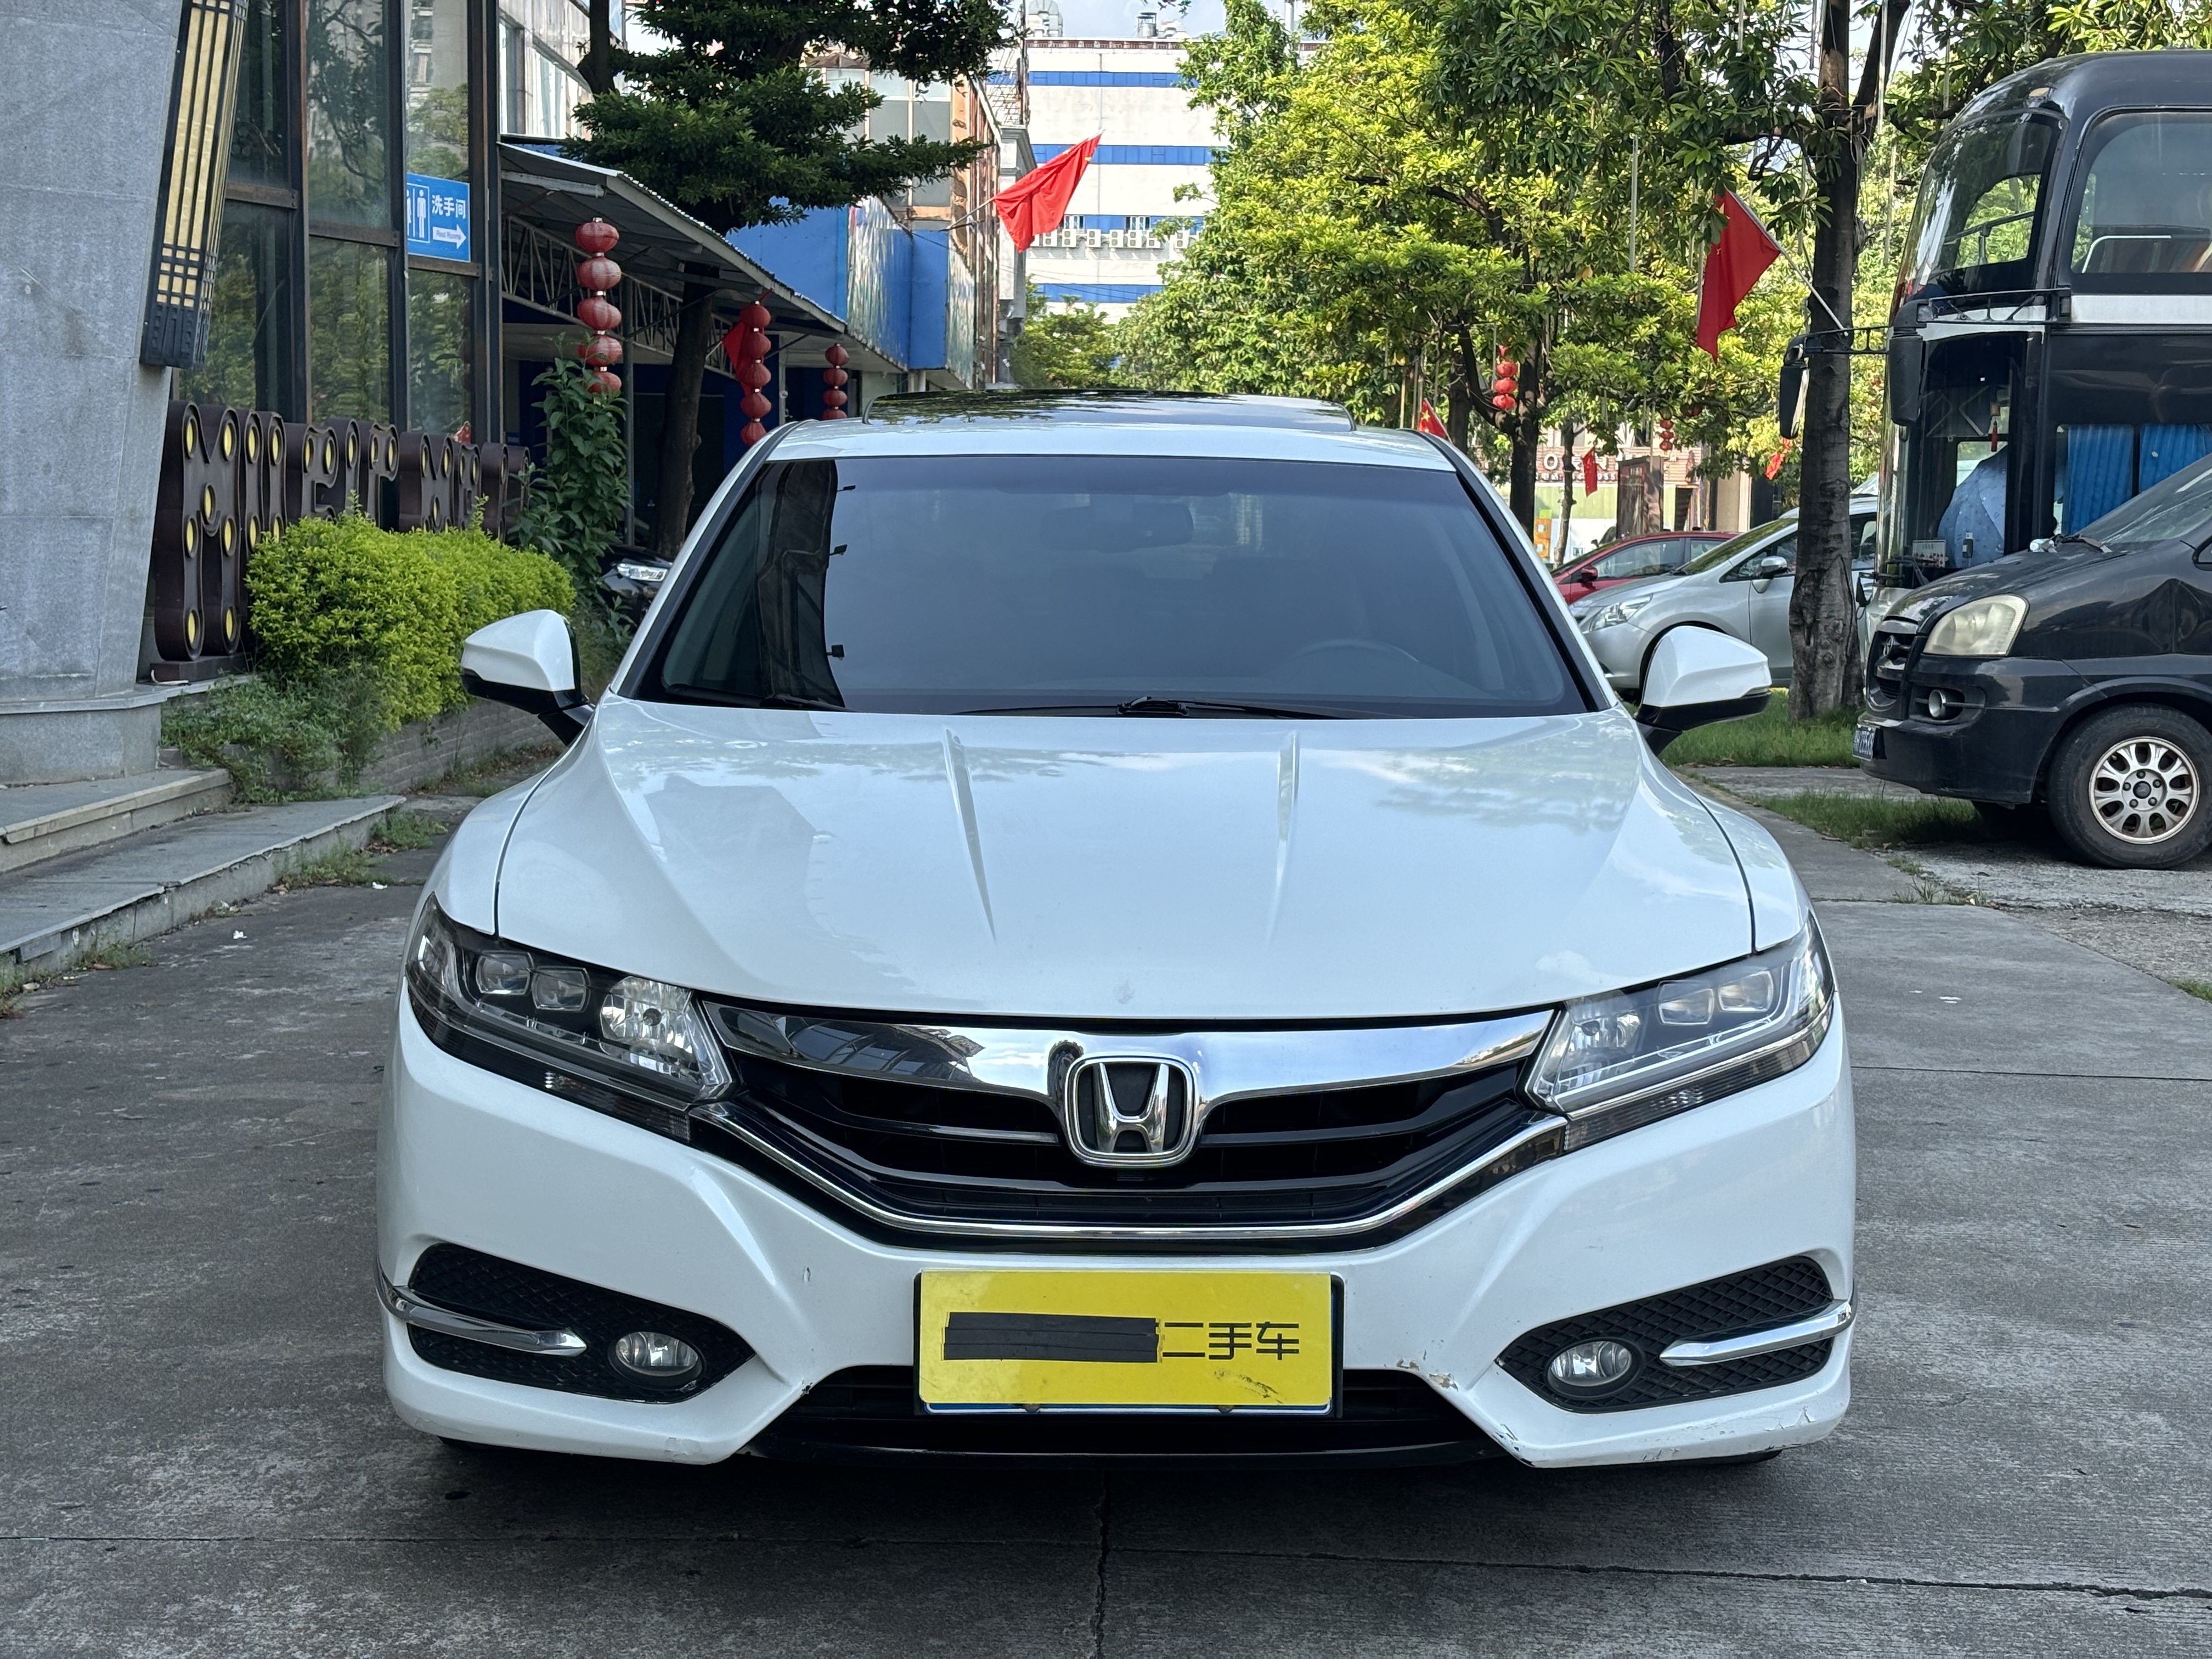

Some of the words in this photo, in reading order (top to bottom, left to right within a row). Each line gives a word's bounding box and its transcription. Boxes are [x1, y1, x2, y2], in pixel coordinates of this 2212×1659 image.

[432, 194, 466, 219] 洗手间
[1162, 1321, 1300, 1361] 二手车
